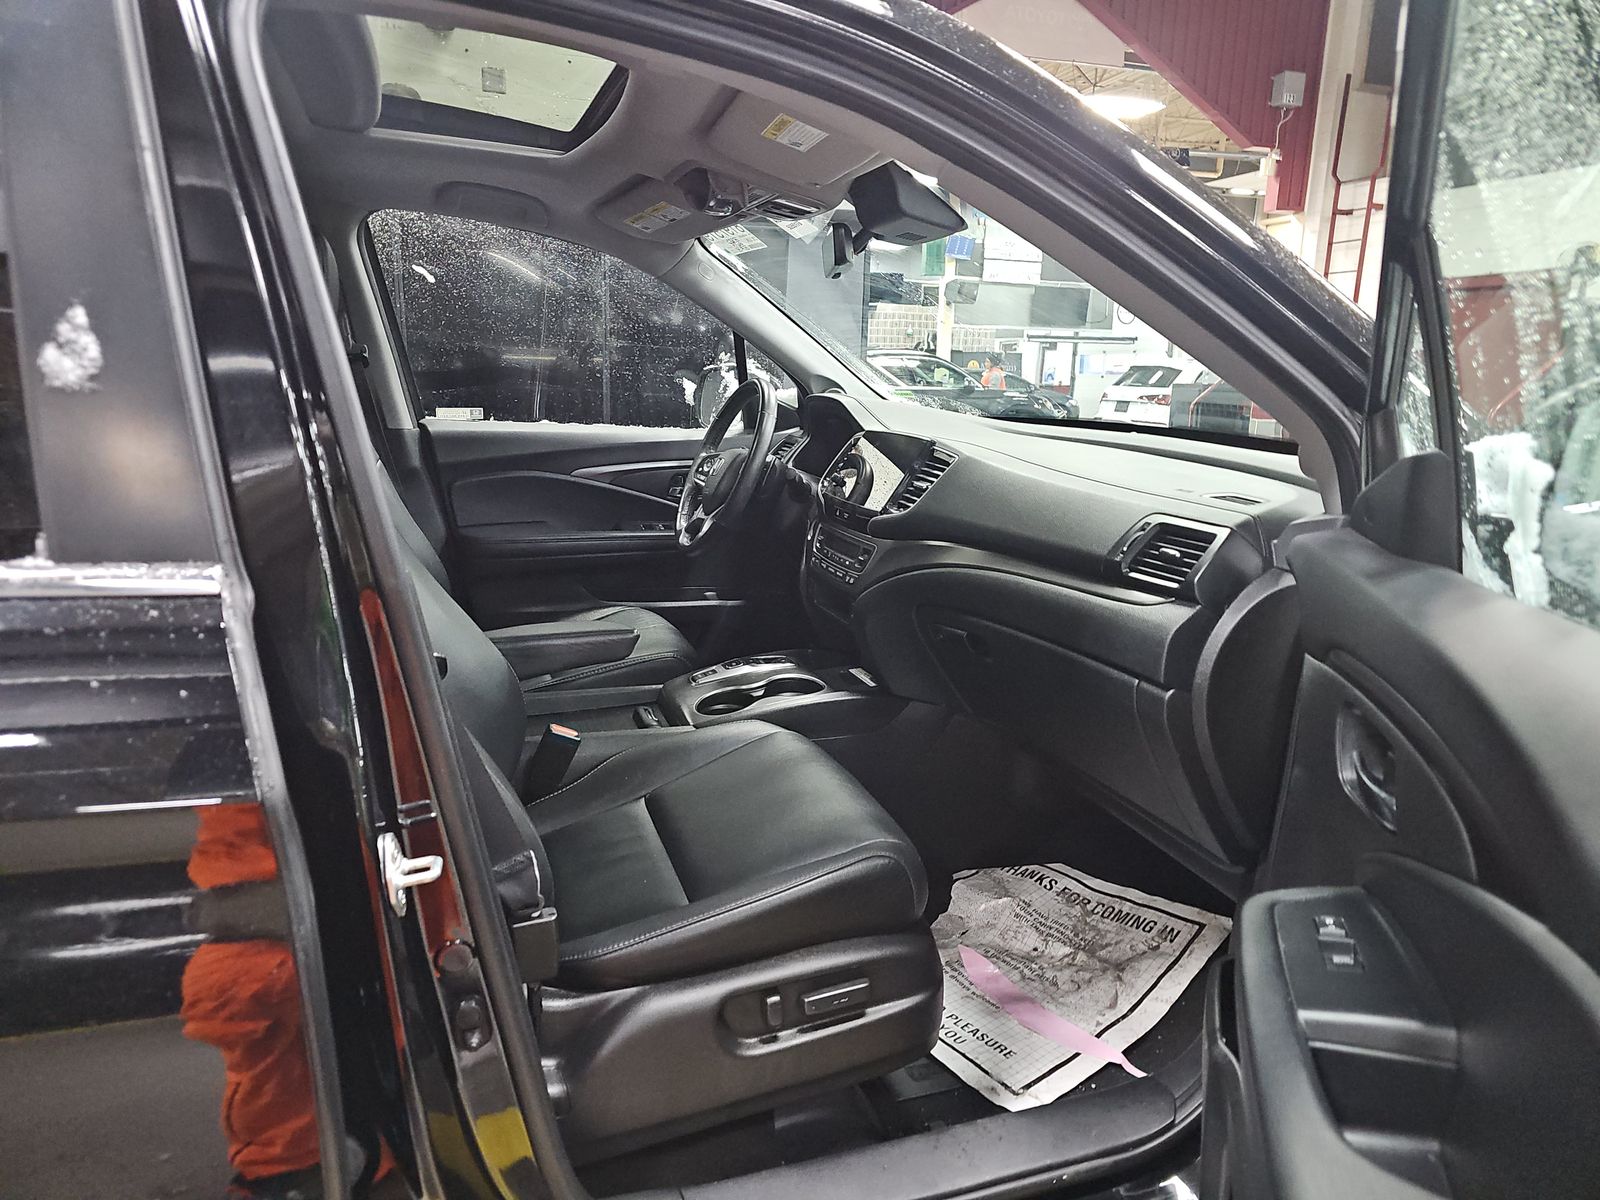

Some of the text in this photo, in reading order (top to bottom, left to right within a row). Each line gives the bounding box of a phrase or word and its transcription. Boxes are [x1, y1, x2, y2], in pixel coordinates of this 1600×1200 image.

[1013, 911, 1031, 925] WITH
[1016, 902, 1034, 917] YOUR
[1056, 886, 1092, 909] FOR
[1091, 901, 1158, 934] COMING
[1161, 924, 1182, 944] IN
[939, 1023, 968, 1045] YOU
[945, 1012, 1017, 1060] PLEASURE
